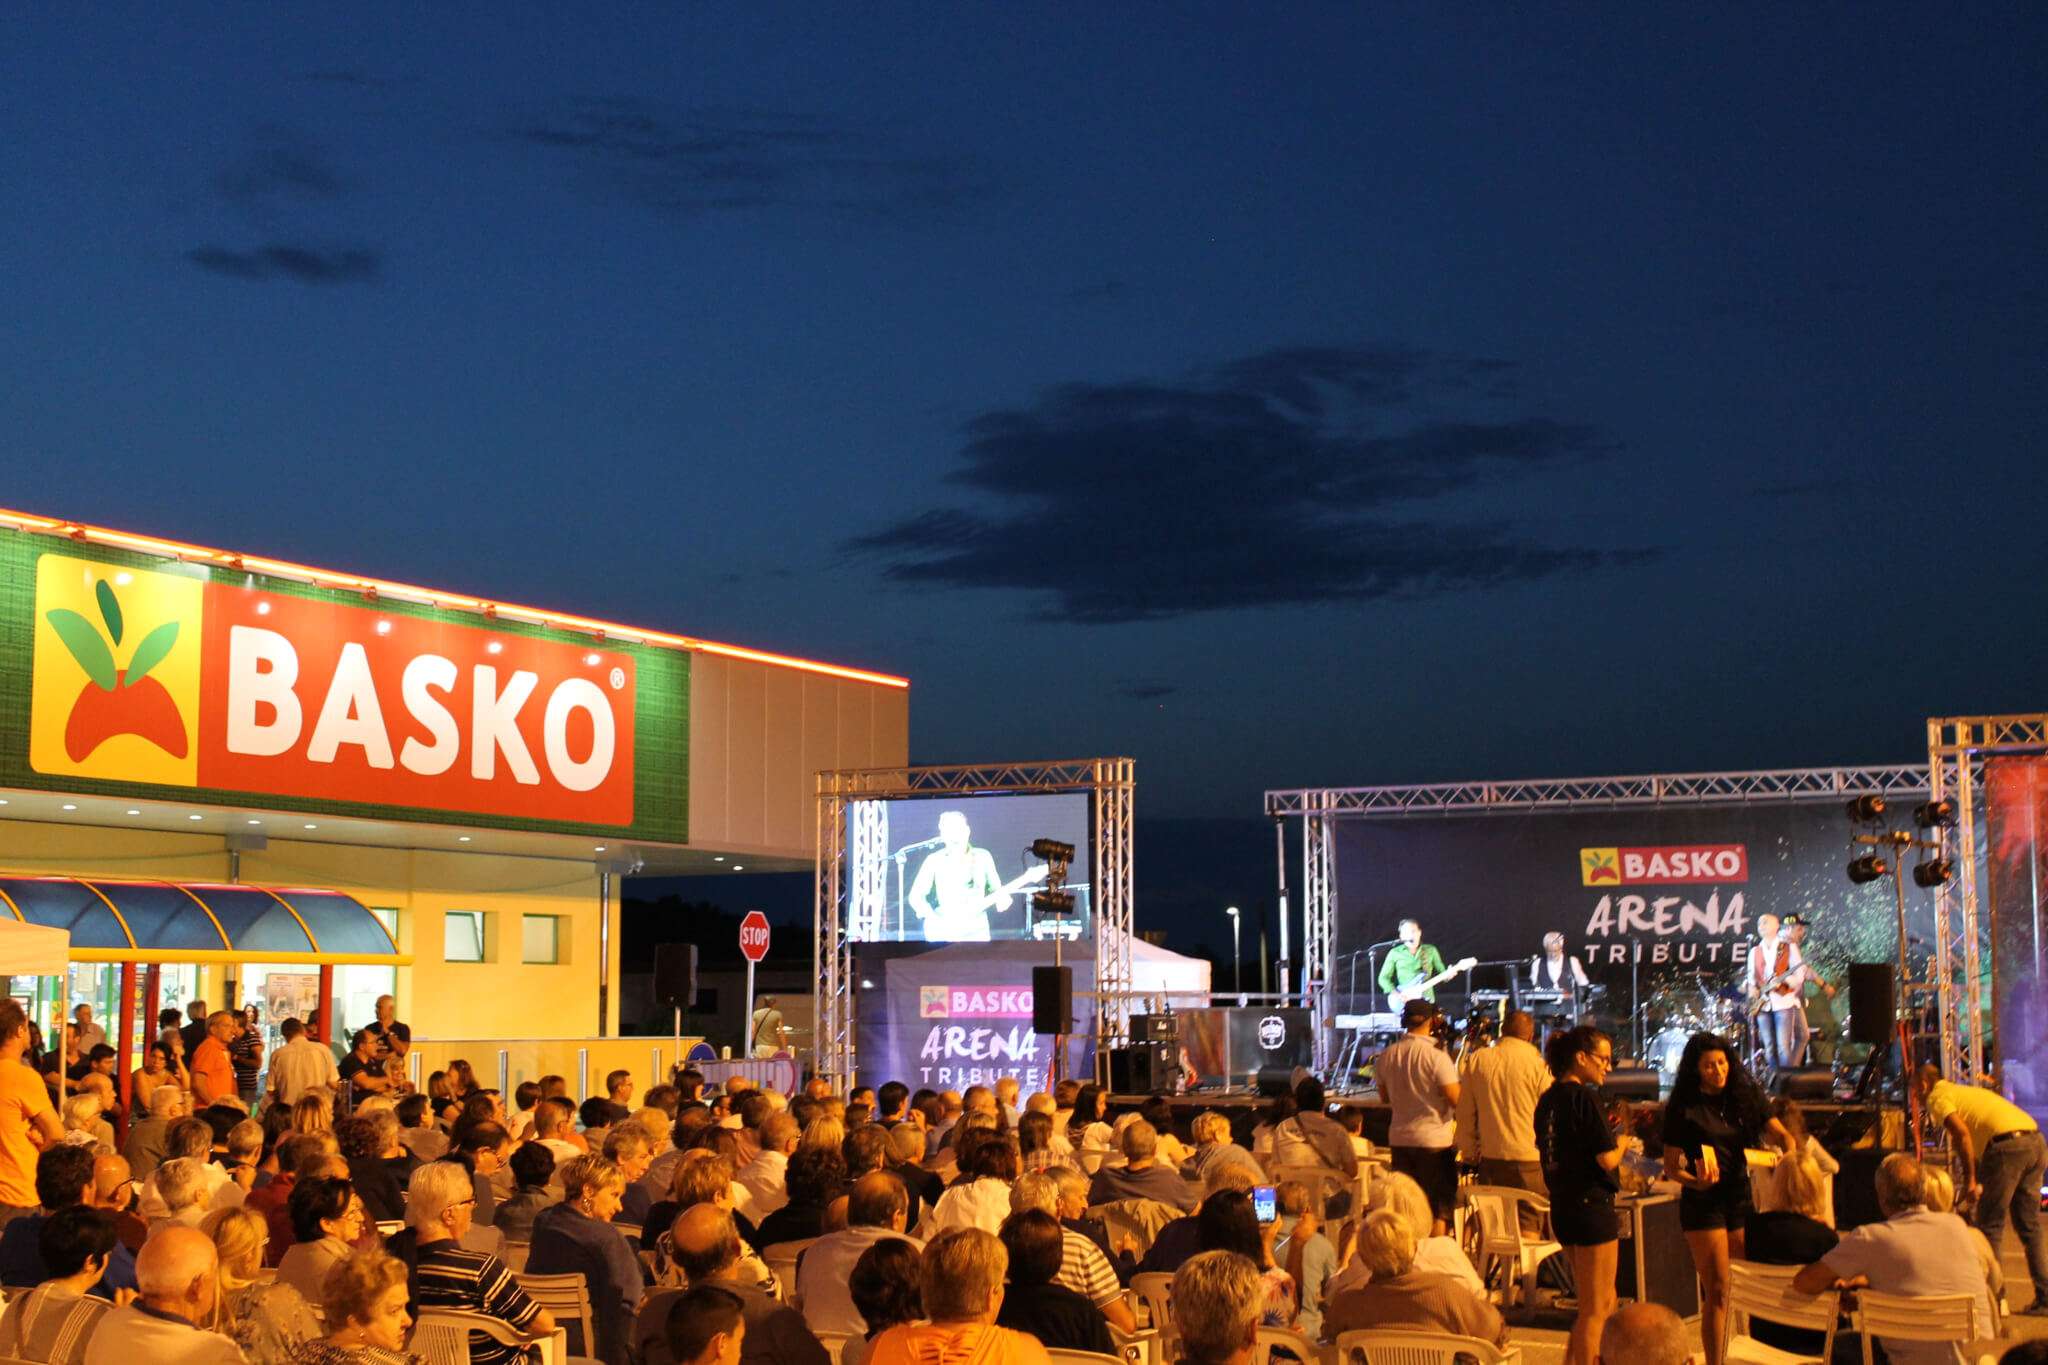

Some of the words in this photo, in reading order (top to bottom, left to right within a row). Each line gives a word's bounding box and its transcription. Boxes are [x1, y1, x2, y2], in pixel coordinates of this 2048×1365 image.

[227, 624, 616, 792] BASKO
[1624, 850, 1741, 879] BASKO
[1585, 887, 1749, 938] ARENA
[743, 926, 768, 946] STOP
[1584, 942, 1748, 964] TRIBUTE
[952, 991, 1034, 1013] BASKO
[920, 1024, 1040, 1062] ARENA
[920, 1066, 1039, 1086] TRIBUTE
